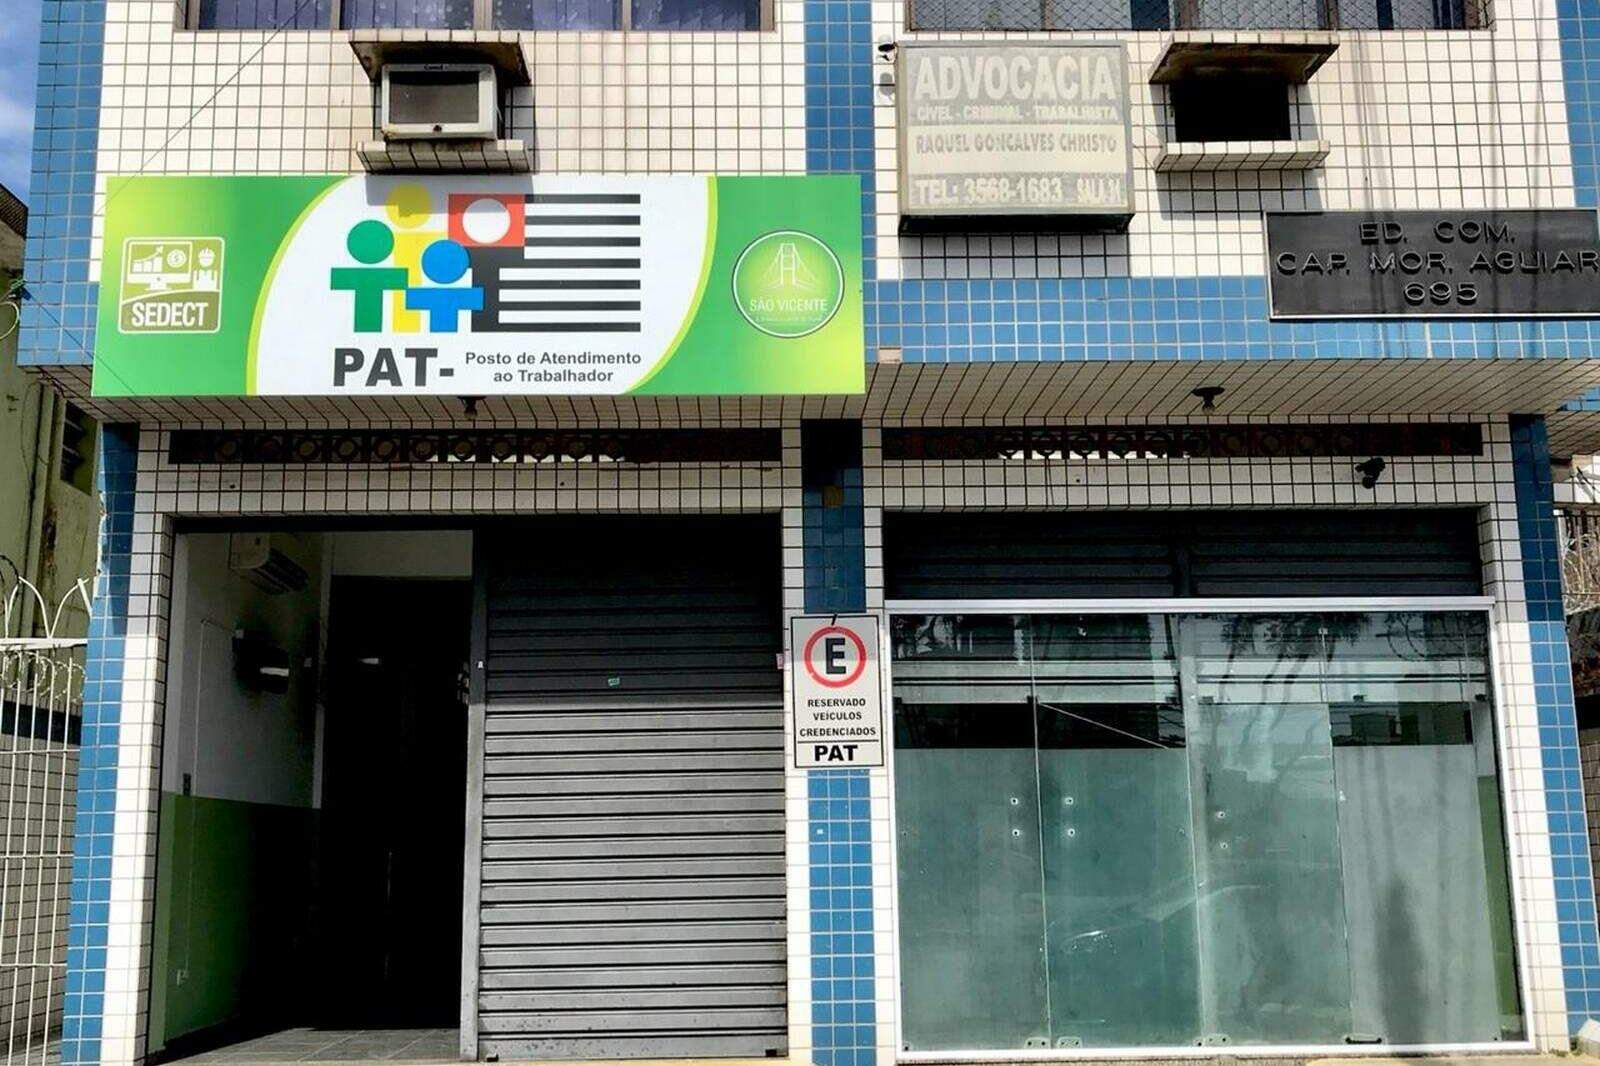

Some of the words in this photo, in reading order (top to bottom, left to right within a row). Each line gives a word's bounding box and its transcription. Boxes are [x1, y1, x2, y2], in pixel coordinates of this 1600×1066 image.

[915, 55, 1116, 100] ADVOCACIA
[916, 133, 969, 154] RAQUEL
[1060, 133, 1117, 153] CHRISTO
[964, 178, 1062, 204] 3568-1683
[1359, 221, 1408, 244] ED.
[1434, 220, 1516, 244] COM.
[1276, 252, 1350, 275] CAP.
[1369, 251, 1453, 275] MOR.
[1470, 250, 1600, 274] AGUIAR
[1404, 281, 1478, 305] 695
[131, 302, 209, 327] SEDECT
[776, 299, 828, 312] VICENTE
[466, 352, 511, 365] Posto
[516, 352, 536, 365] de
[540, 352, 642, 365] Atendimento
[493, 372, 512, 383] ao
[518, 369, 614, 382] Trabalhador
[825, 637, 846, 674] E
[808, 698, 866, 707] RESERVADO
[799, 727, 876, 737] CREDENCIADOS
[814, 745, 858, 761] PAT
